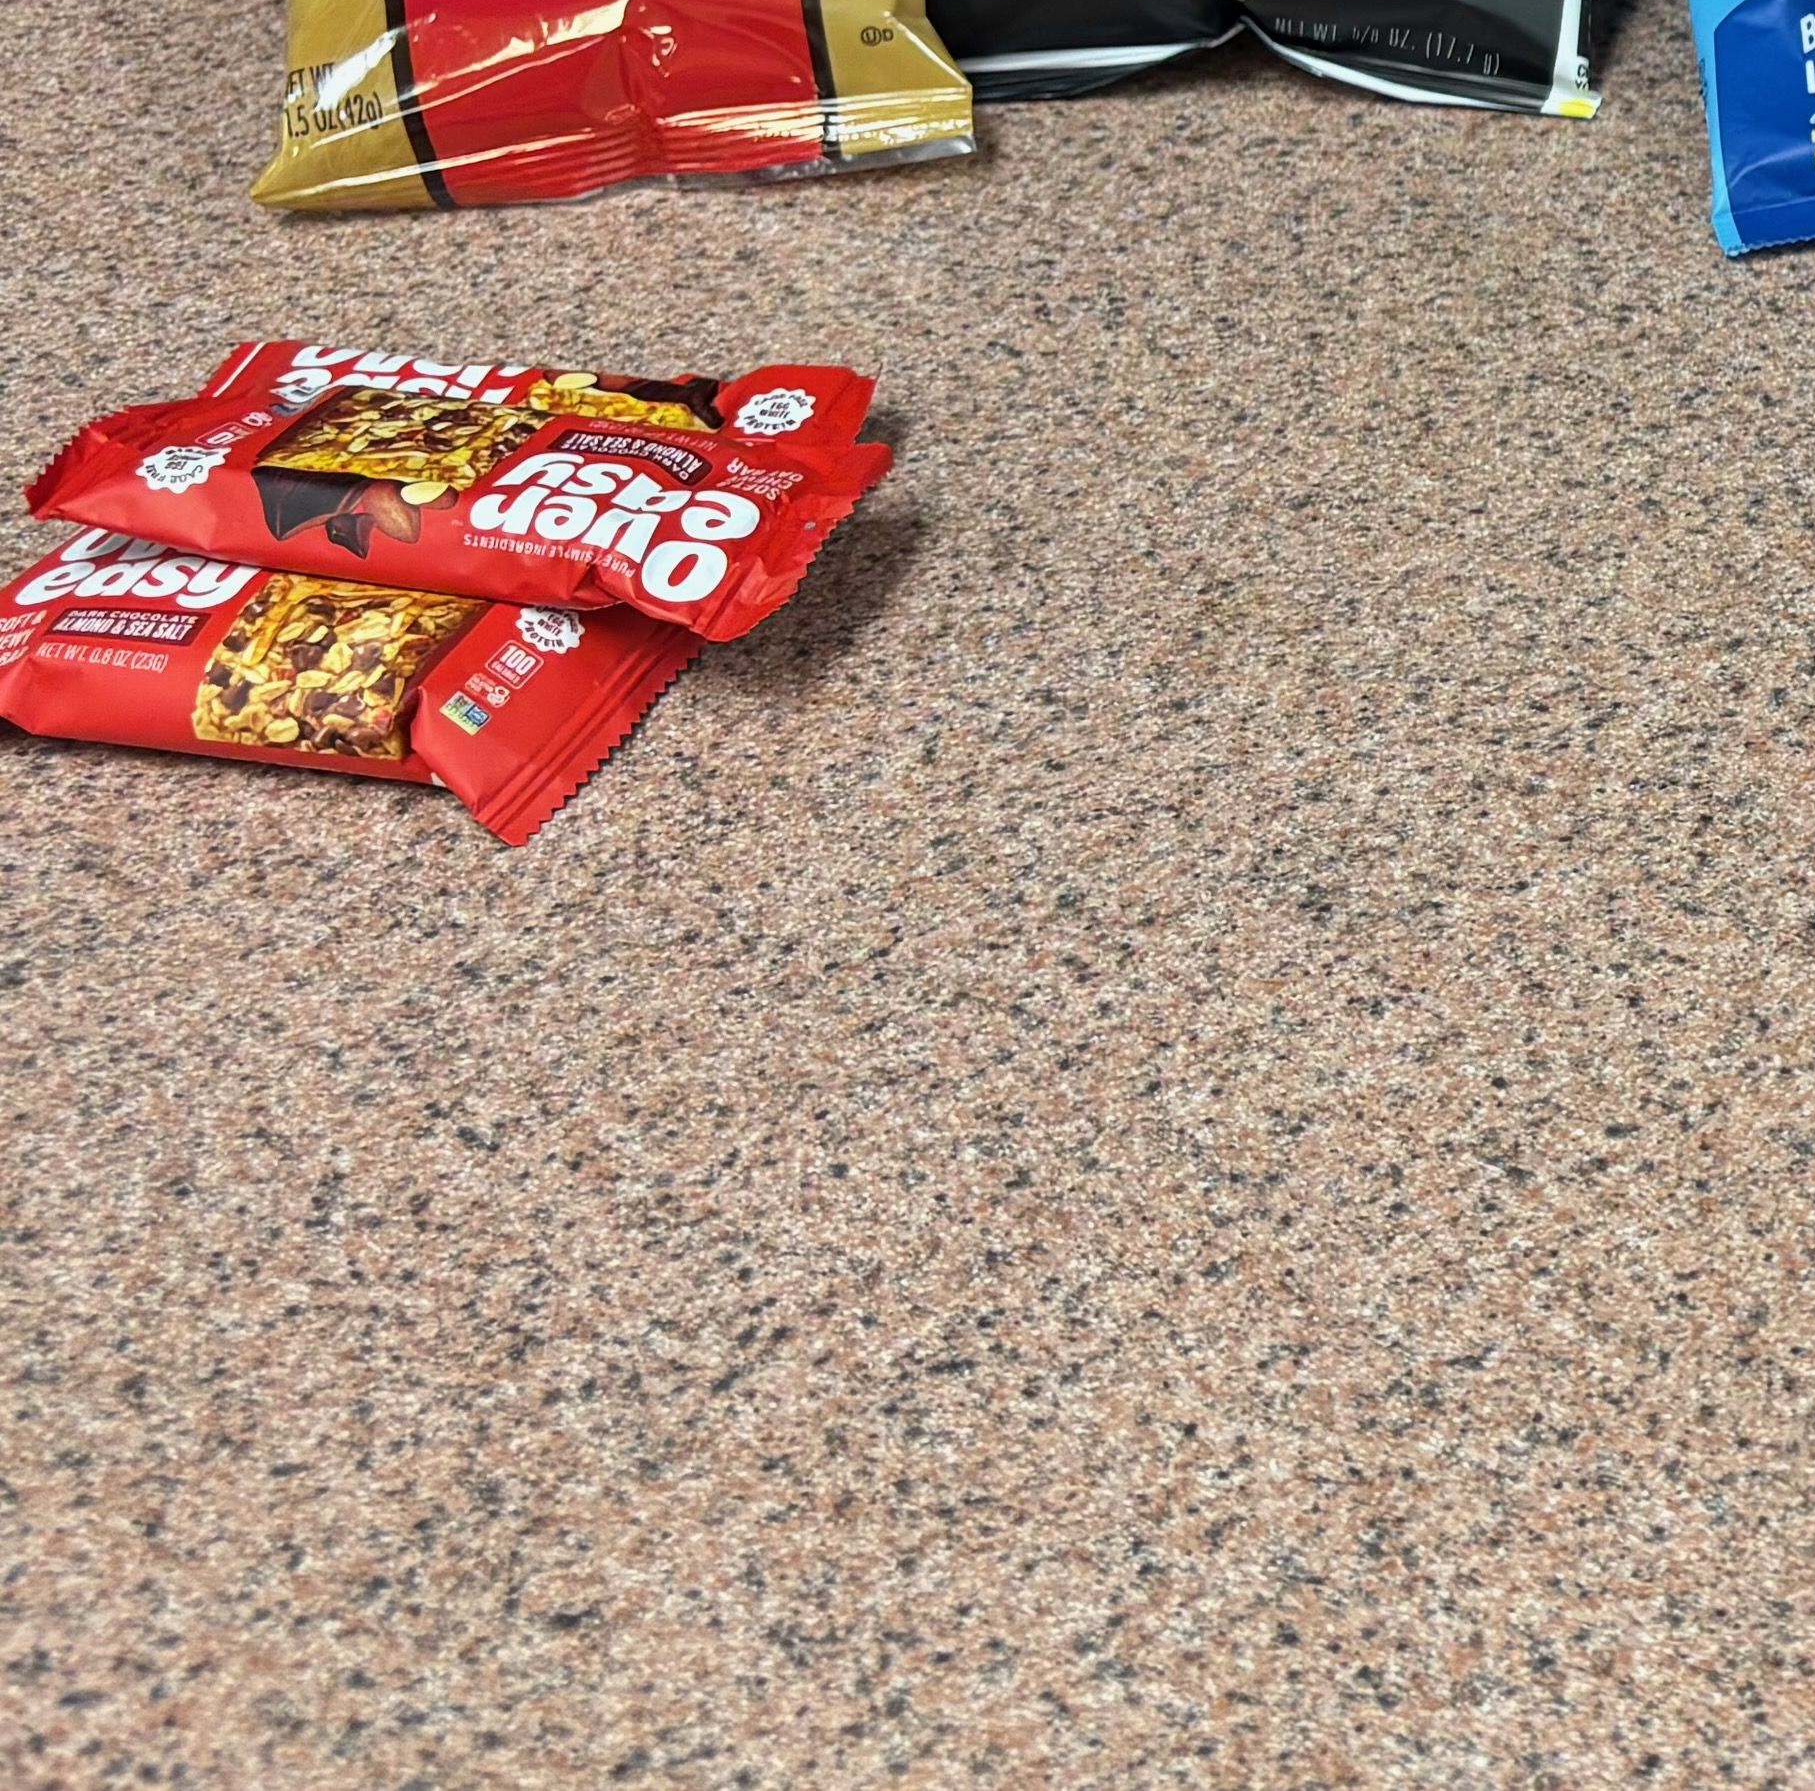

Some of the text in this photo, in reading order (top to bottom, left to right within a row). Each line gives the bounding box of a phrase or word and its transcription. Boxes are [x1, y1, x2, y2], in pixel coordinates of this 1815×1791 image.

[491, 451, 760, 541] easy
[54, 616, 112, 636] ALMOND
[124, 620, 153, 638] SEA
[154, 621, 193, 642] SALT
[500, 646, 537, 676] 100
